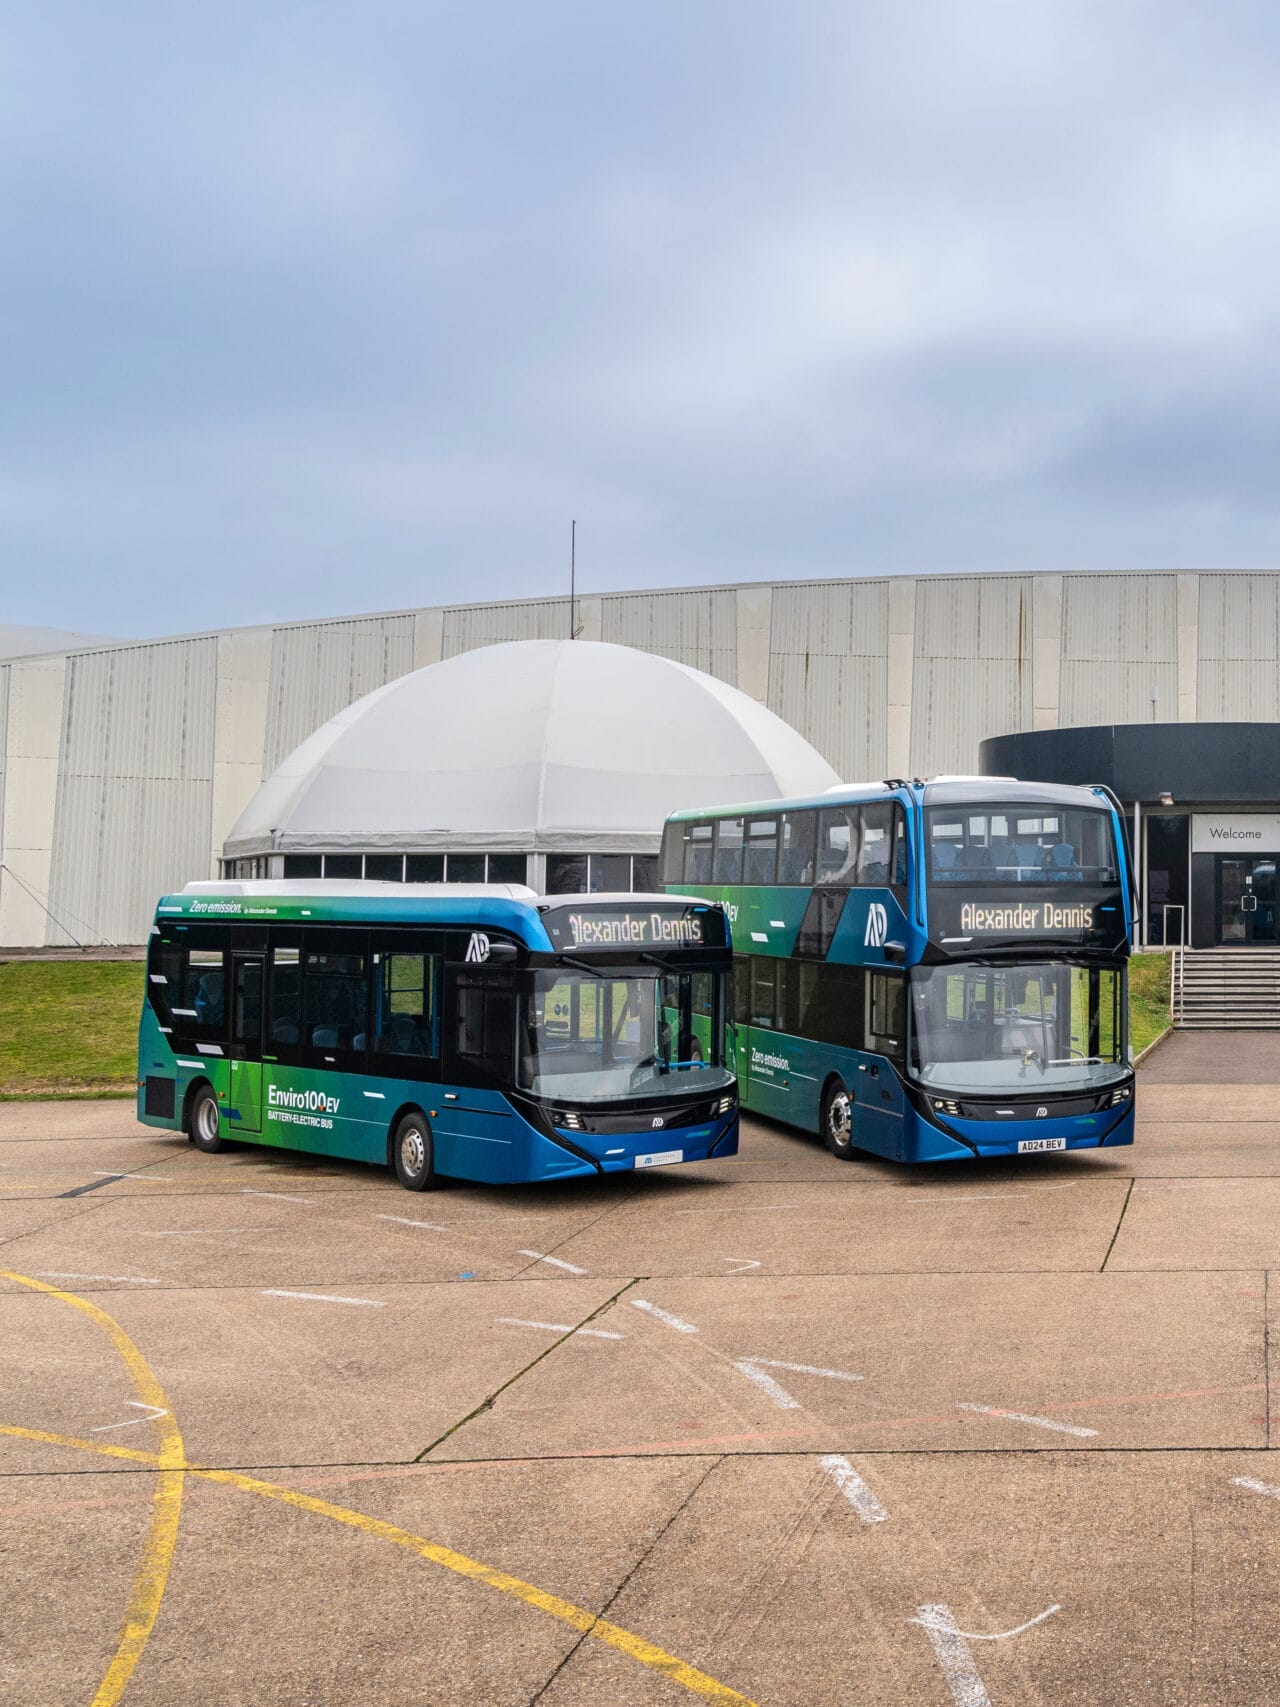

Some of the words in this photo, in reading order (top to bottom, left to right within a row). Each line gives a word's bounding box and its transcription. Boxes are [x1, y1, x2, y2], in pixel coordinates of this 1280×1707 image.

[1209, 827, 1262, 840] Welcome
[190, 900, 207, 913] Zero
[207, 901, 242, 913] emission.
[961, 903, 1037, 930] Alexander
[1043, 903, 1093, 929] Dennis
[568, 913, 648, 943] Alexander
[650, 914, 701, 941] Dennis
[752, 1047, 764, 1064] Zero
[268, 1084, 340, 1113] Enviro100EV
[267, 1110, 320, 1127] BATTERY-ELECTRIC
[320, 1119, 334, 1129] BUS
[1022, 1142, 1044, 1151] AD24
[1046, 1139, 1062, 1149] BEV
